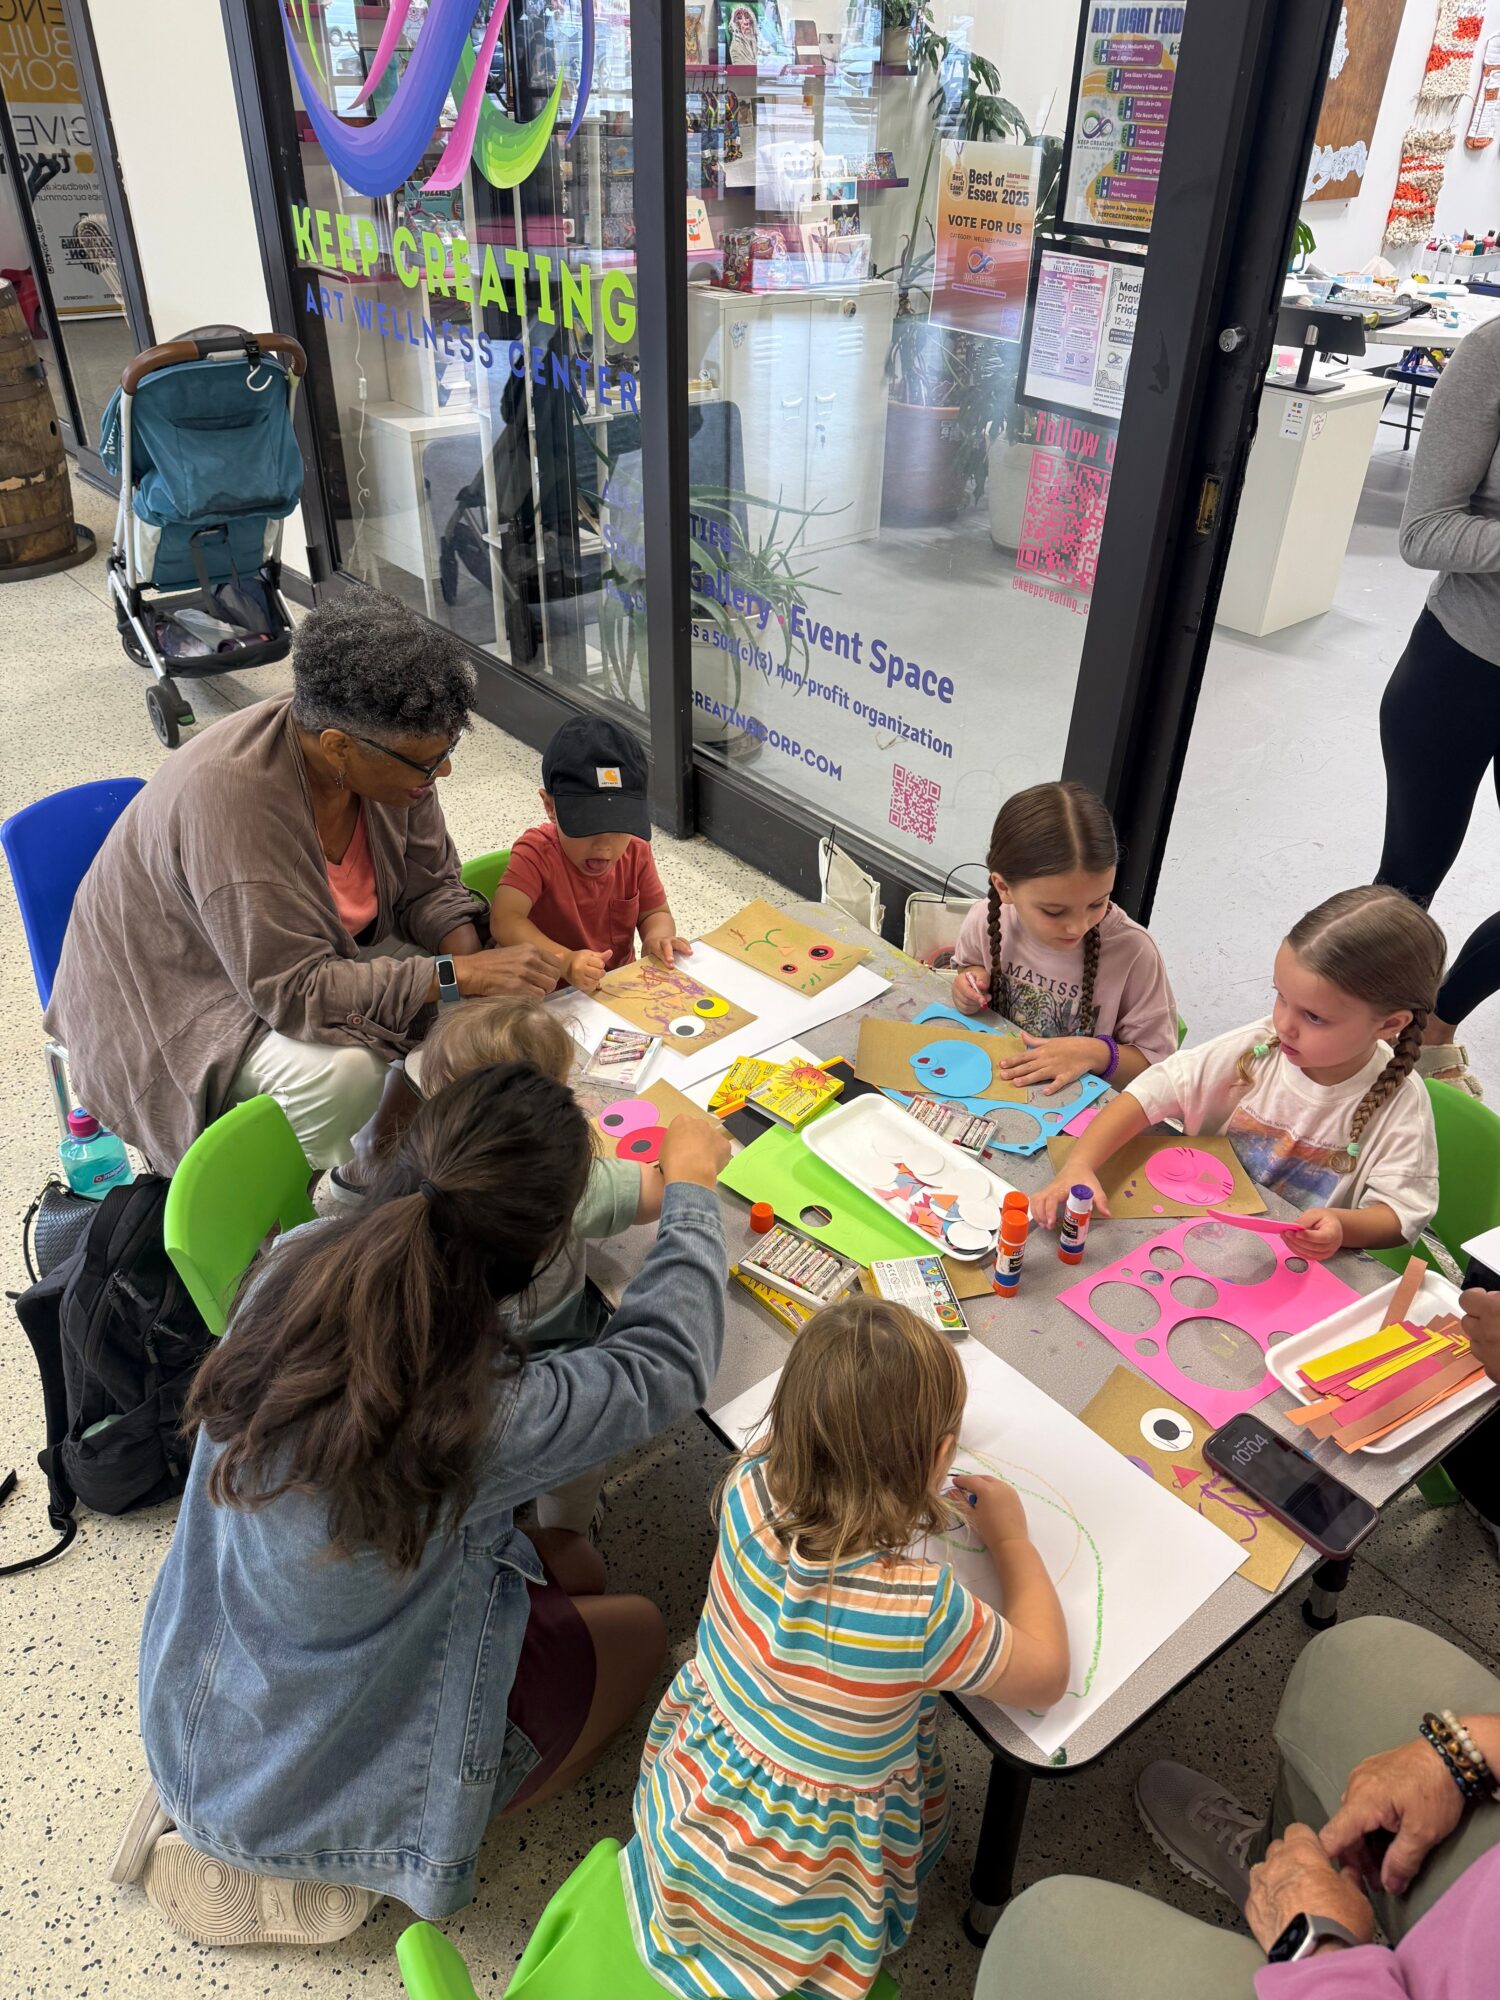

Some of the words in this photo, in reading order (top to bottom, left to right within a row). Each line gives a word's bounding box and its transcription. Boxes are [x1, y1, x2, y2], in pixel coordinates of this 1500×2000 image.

[1091, 8, 1116, 33] ART
[1116, 8, 1153, 33] NIGHT
[969, 169, 992, 186] Best
[995, 175, 1005, 188] of
[967, 185, 998, 203] Essex
[1001, 189, 1029, 207] 2025
[948, 214, 977, 229] VOTE
[980, 219, 1003, 233] FOR
[1006, 222, 1023, 235] US
[292, 204, 379, 277] KEEP
[392, 226, 637, 344] CREATING
[1053, 264, 1062, 272] FALL
[1120, 282, 1142, 293] Medi
[306, 282, 344, 323] ART
[353, 296, 495, 369] WELLNESS
[509, 340, 639, 414] CENTER
[1035, 411, 1101, 459] follow
[1012, 575, 1089, 616] @keepcreating_c
[791, 604, 862, 664] Event
[869, 639, 954, 704] Space
[702, 630, 710, 643] a
[712, 630, 773, 677] 501(c)(3)
[776, 662, 850, 710] non-profit
[853, 700, 954, 759] organization
[1006, 962, 1079, 998] MATISS
[1231, 1434, 1269, 1466] 10:04
